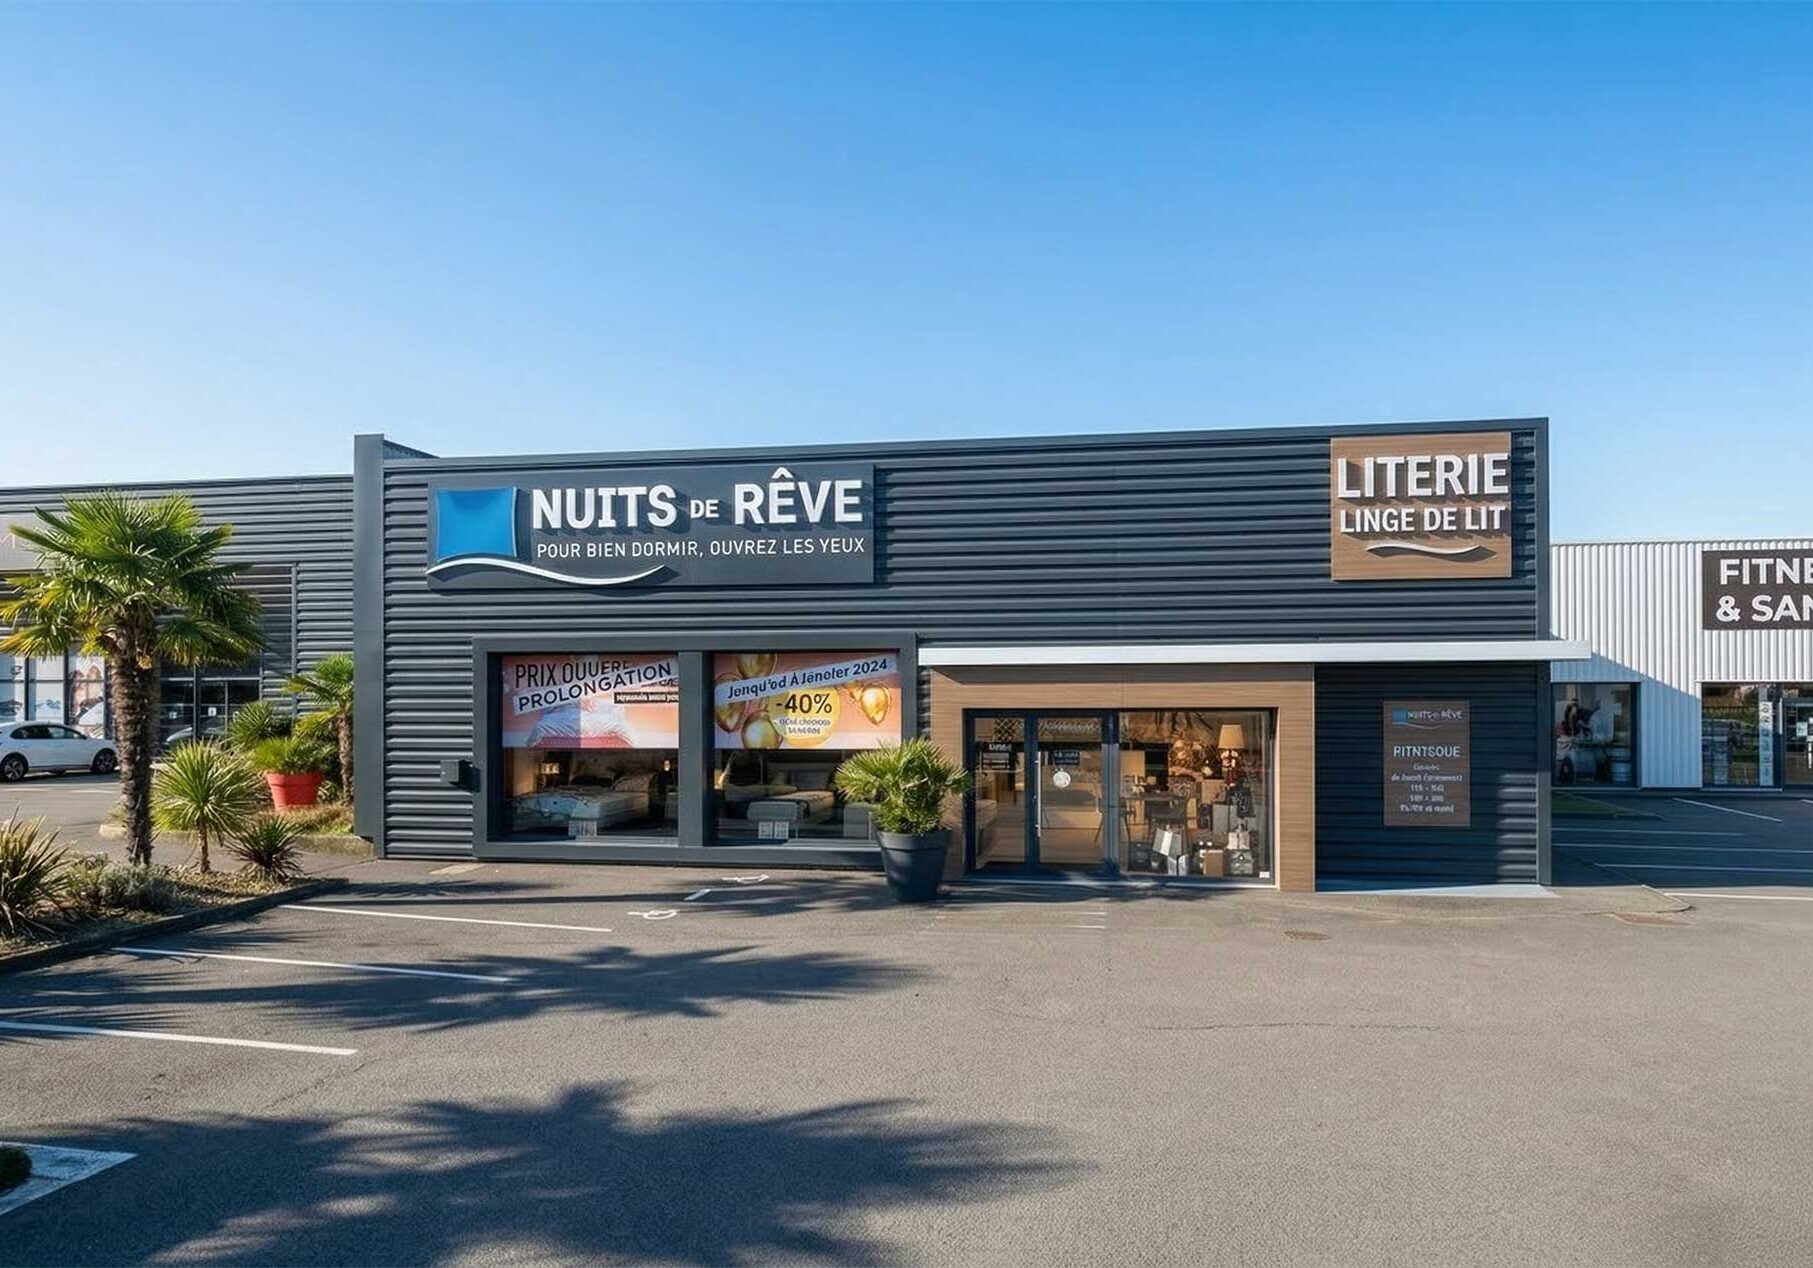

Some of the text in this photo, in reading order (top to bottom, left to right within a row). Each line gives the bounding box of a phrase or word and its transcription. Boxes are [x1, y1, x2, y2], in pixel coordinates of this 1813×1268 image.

[1337, 453, 1509, 498] LITERIE
[532, 467, 863, 529] NUITS DE RÊVE
[1340, 505, 1506, 533] LINGE DE LIT
[537, 537, 865, 558] POUR BIEN DORMIR, OUVREZ LES YEUX
[1716, 595, 1741, 622] &
[515, 663, 557, 688] PRIX
[853, 658, 888, 676] 2024
[518, 662, 672, 711] PROLONGATION
[776, 693, 833, 714] -40%
